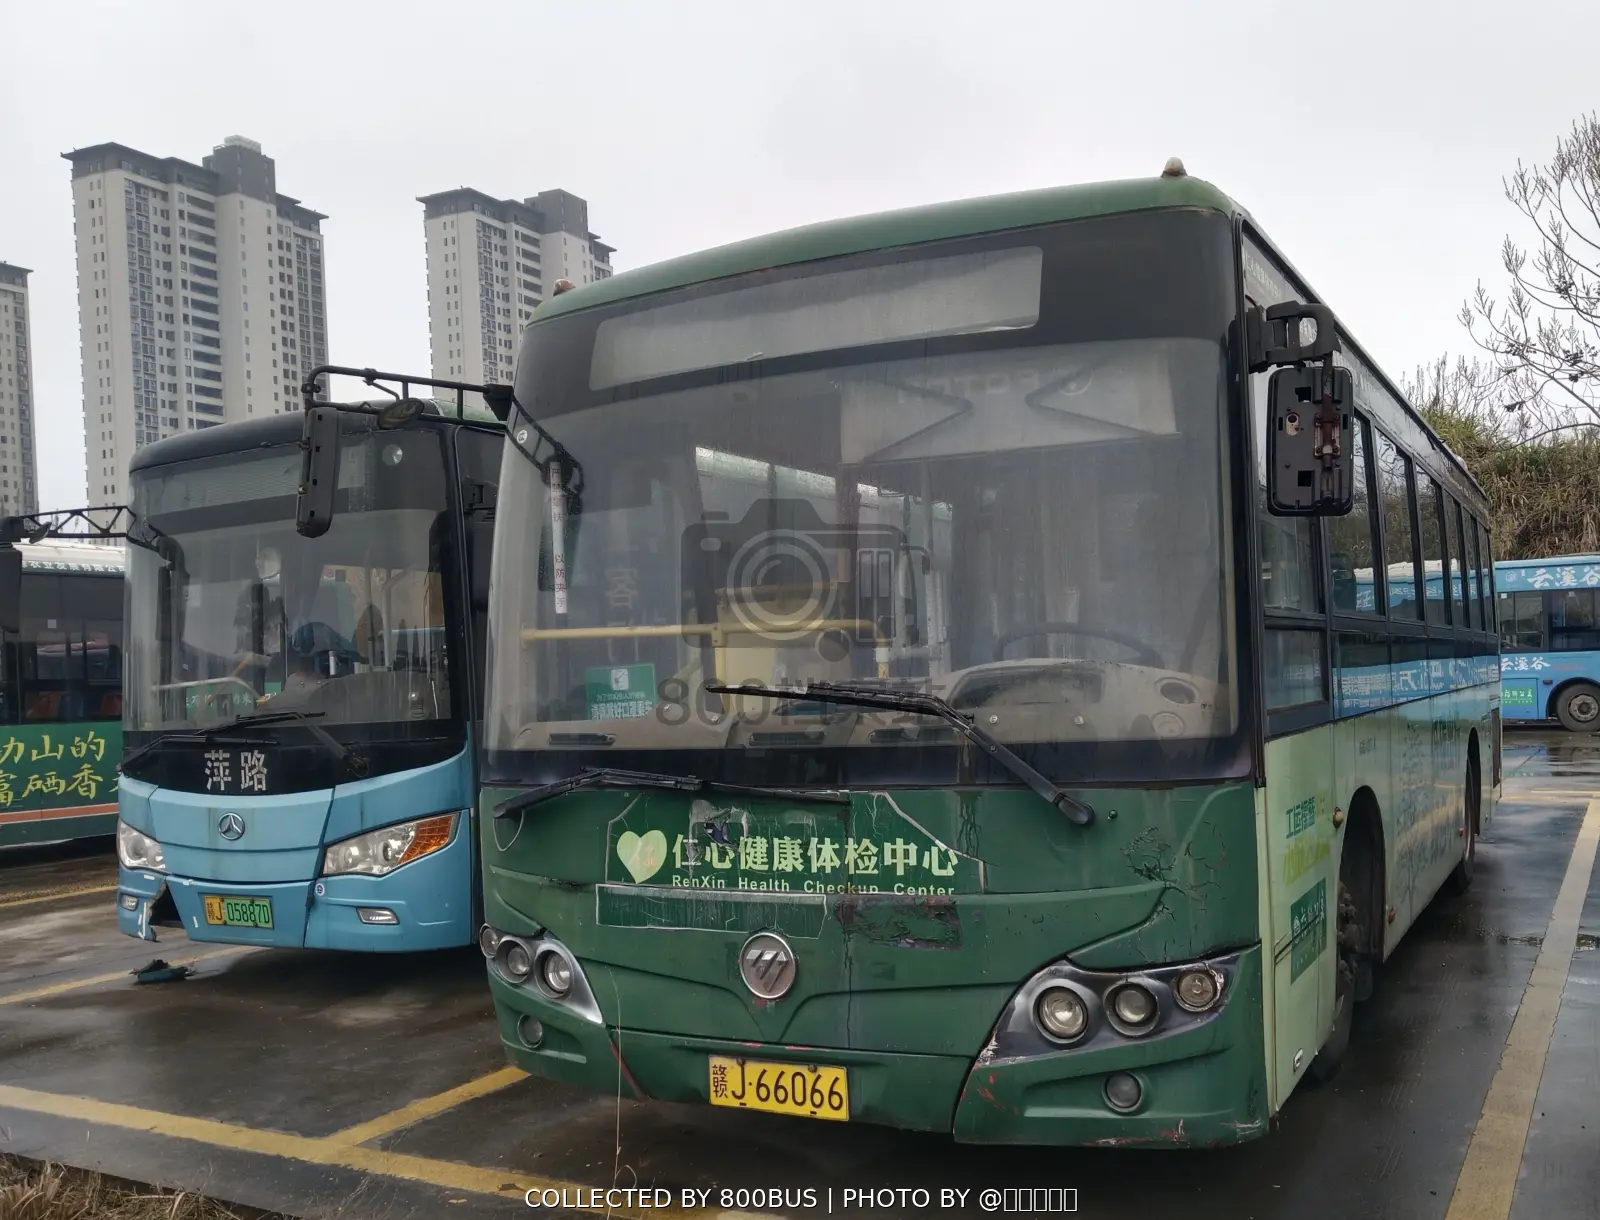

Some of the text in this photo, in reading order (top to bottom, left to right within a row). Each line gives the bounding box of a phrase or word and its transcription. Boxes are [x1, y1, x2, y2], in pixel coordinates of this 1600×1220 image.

[204, 749, 268, 791] 萍路
[672, 875, 955, 896] RenXin Health Checkup Center
